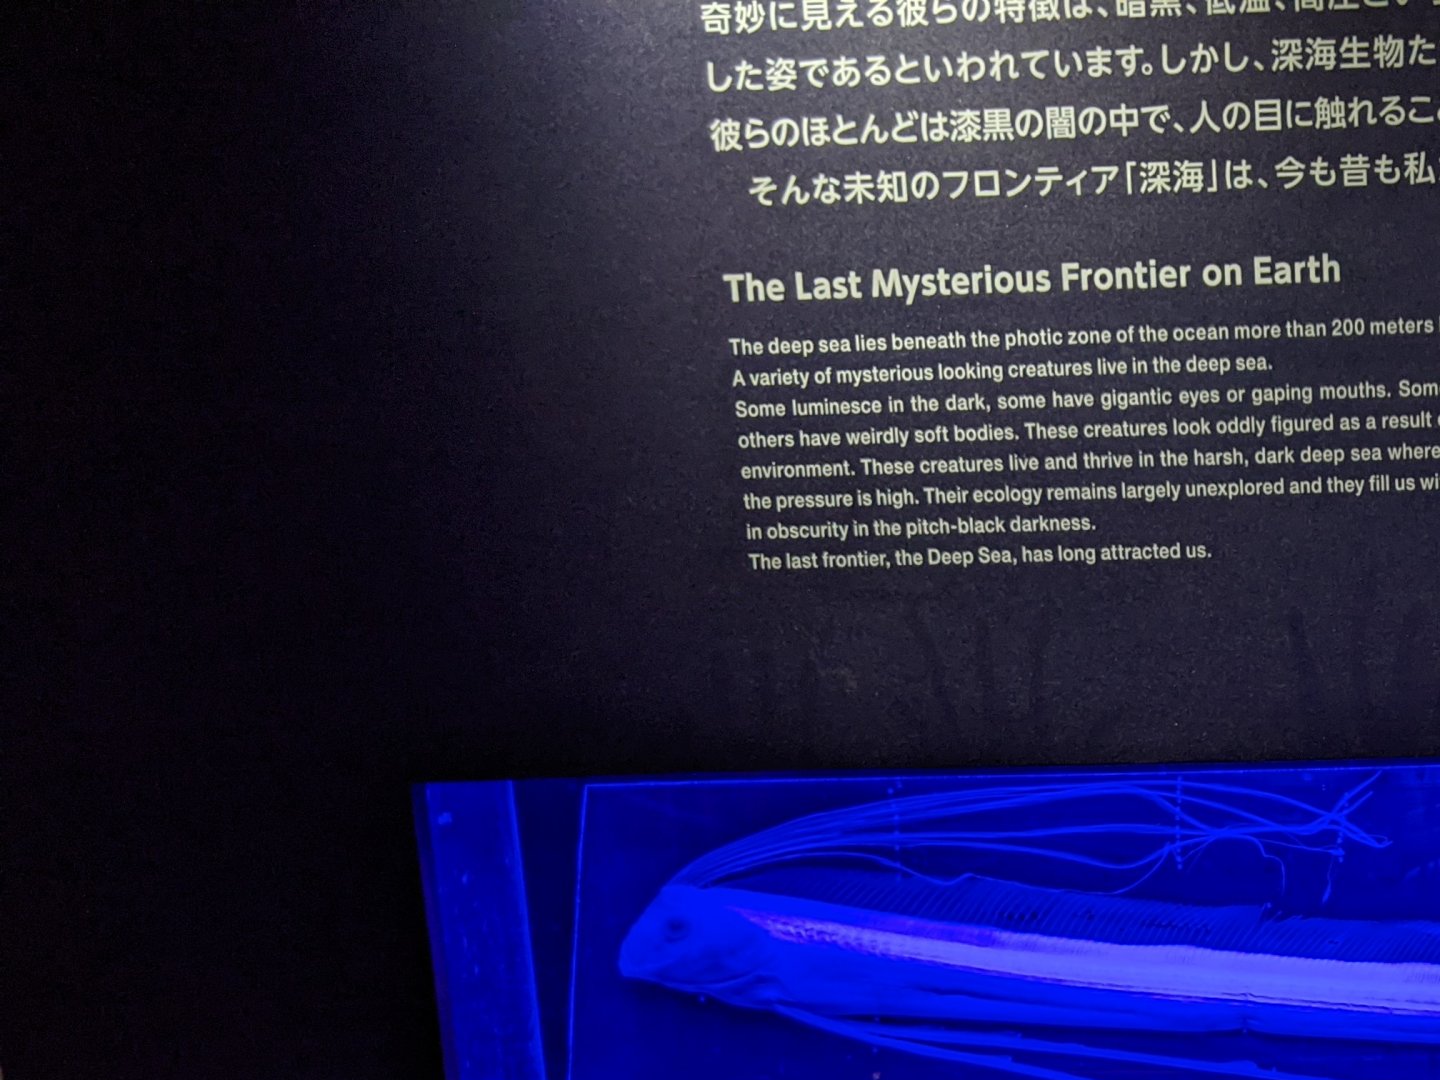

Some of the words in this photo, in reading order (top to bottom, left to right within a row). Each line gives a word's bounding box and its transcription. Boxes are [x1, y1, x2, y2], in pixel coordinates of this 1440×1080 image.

[721, 271, 786, 303] The
[794, 270, 863, 301] Last
[871, 264, 1052, 305] Mysterious
[1060, 258, 1192, 292] Frontier
[1201, 262, 1243, 287] on
[1253, 252, 1341, 285] Earth
[727, 337, 764, 356] The
[767, 336, 815, 358] deep
[817, 338, 852, 354] sea
[854, 333, 888, 352] lies
[890, 330, 967, 351] beneath
[969, 329, 1001, 348] the
[1004, 327, 1064, 351] photic
[1067, 329, 1112, 345] zone
[1115, 324, 1135, 344] of
[1137, 324, 1169, 343] the
[1172, 325, 1230, 342] ocean
[1234, 324, 1282, 340] more
[1285, 319, 1327, 338] than
[1331, 317, 1366, 337] 200
[1369, 316, 1435, 336] meters
[731, 369, 747, 388] A
[748, 367, 810, 390] variety
[813, 366, 832, 385] of
[835, 364, 935, 388] mysterious
[937, 361, 1004, 383] looking
[1007, 359, 1094, 379] creatures
[1096, 357, 1128, 376] live
[1131, 356, 1149, 375] in
[1151, 355, 1182, 374] the
[1185, 354, 1231, 376] deep
[1235, 356, 1273, 372] sea.
[734, 399, 786, 418] Some
[791, 397, 883, 417] luminesce
[887, 395, 905, 413] in
[909, 394, 940, 413] the
[944, 392, 991, 413] dark,
[997, 394, 1047, 410] some
[1051, 389, 1095, 408] have
[1100, 386, 1173, 411] gigantic
[1178, 389, 1221, 409] eyes
[1226, 388, 1246, 403] or
[1251, 382, 1313, 406] gaping
[1319, 380, 1392, 400] mouths.
[737, 430, 795, 449] others
[798, 429, 842, 447] have
[845, 426, 910, 448] weirdly
[914, 424, 950, 444] soft
[953, 423, 1020, 443] bodies.
[1023, 421, 1079, 440] These
[1083, 420, 1168, 439] creatures
[1172, 416, 1212, 436] look
[1215, 415, 1266, 438] oddly
[1270, 413, 1334, 437] figured
[1339, 416, 1361, 431] as
[1365, 415, 1377, 430] a
[1381, 410, 1433, 430] result
[740, 459, 856, 480] environment.
[859, 457, 915, 476] These
[919, 456, 1004, 474] creatures
[1008, 453, 1040, 472] live
[1044, 451, 1078, 471] and
[1082, 450, 1134, 470] thrive
[1138, 449, 1155, 468] in
[1159, 449, 1189, 468] the
[1193, 447, 1249, 468] harsh,
[1254, 445, 1296, 465] dark
[1299, 445, 1345, 466] deep
[1350, 446, 1383, 462] sea
[742, 492, 772, 510] the
[775, 493, 854, 513] pressure
[856, 489, 873, 507] is
[875, 487, 920, 510] high.
[922, 485, 970, 505] Their
[972, 484, 1043, 506] ecology
[1046, 482, 1118, 501] remains
[1121, 480, 1181, 503] largely
[1185, 477, 1285, 501] unexplored
[1289, 476, 1323, 495] and
[1326, 475, 1365, 497] they
[1368, 474, 1390, 492] fill
[1394, 477, 1416, 492] us
[746, 523, 763, 541] in
[766, 520, 850, 542] obscurity
[852, 519, 870, 537] in
[872, 519, 902, 537] the
[905, 515, 1007, 540] pitch-black
[1009, 514, 1097, 533] darkness.
[747, 552, 782, 571] The
[785, 552, 819, 570] last
[821, 550, 891, 569] frontier,
[894, 548, 924, 566] the
[927, 547, 975, 569] Deep
[977, 545, 1018, 566] Sea,
[1021, 545, 1054, 563] has
[1057, 544, 1097, 566] long
[1100, 541, 1182, 561] attracted
[1185, 544, 1212, 559] us.
